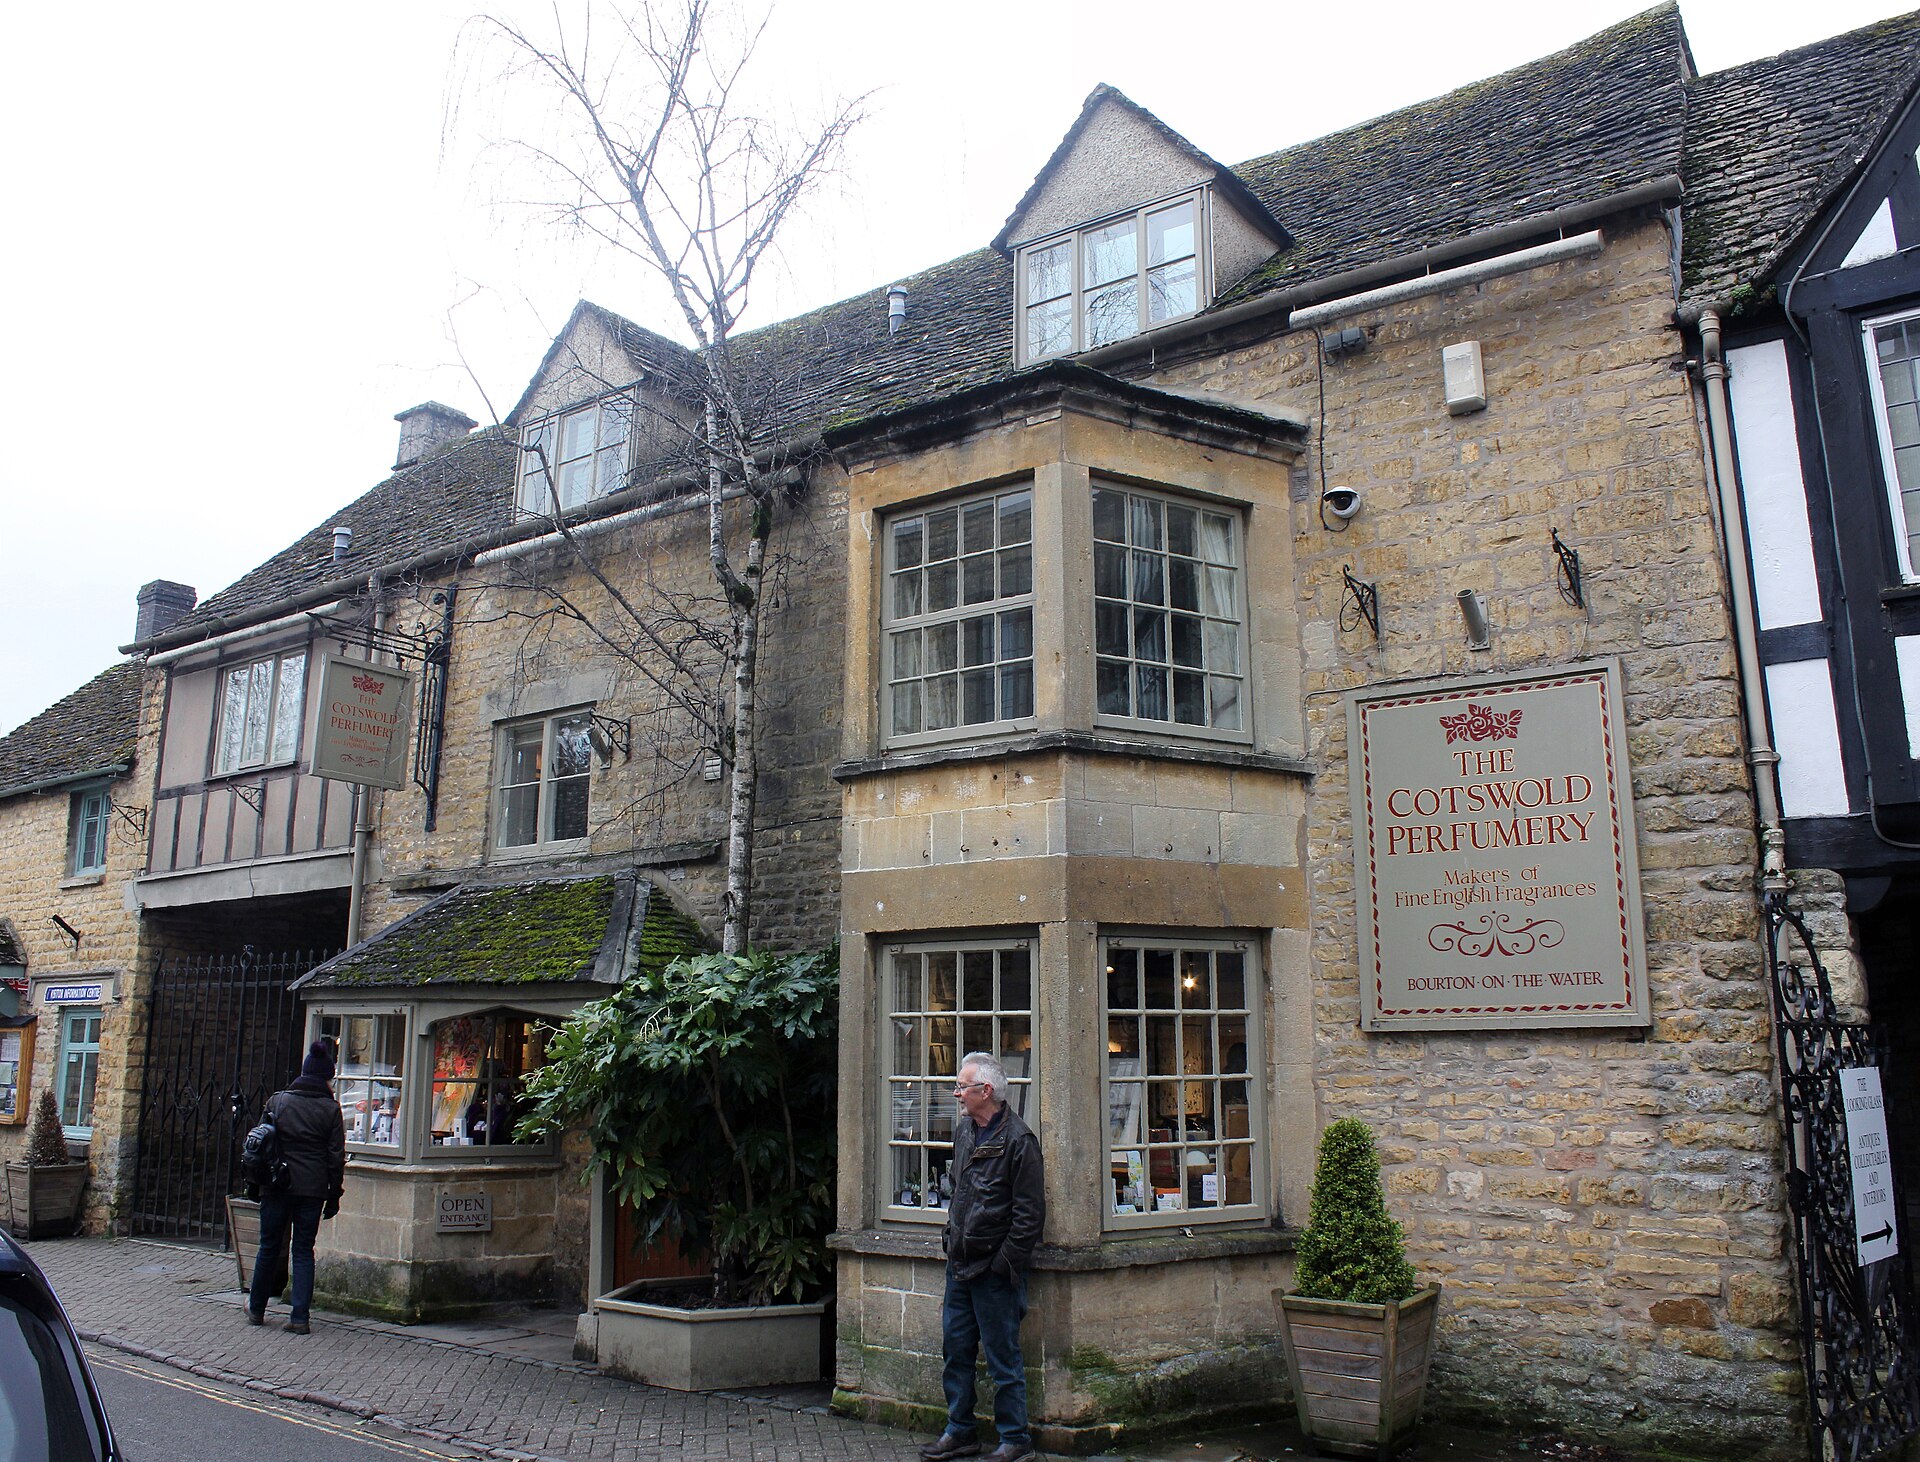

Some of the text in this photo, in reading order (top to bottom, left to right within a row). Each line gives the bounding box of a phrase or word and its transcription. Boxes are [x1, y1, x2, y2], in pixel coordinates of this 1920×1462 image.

[358, 694, 377, 706] THE
[332, 701, 398, 724] COTSWOLD
[331, 716, 396, 738] PERFUMERY
[1453, 748, 1516, 776] THE
[1387, 774, 1592, 819] COTSWOLD
[1386, 811, 1596, 856] PERFUMERY
[1444, 864, 1541, 886] Makers of
[1395, 882, 1597, 911] Fine English Fragrances
[1408, 971, 1604, 991] BOURTON ON THE WATER
[86, 986, 101, 998] CENTRE
[1857, 1077, 1867, 1091] THE
[1858, 1132, 1881, 1150] ANTIQUES
[1854, 1150, 1888, 1169] COLLECTABLES
[1868, 1171, 1879, 1186] AND
[441, 1198, 485, 1212] OPEN
[1863, 1188, 1887, 1207] INTERIORS
[440, 1213, 489, 1223] ENTRANCE
